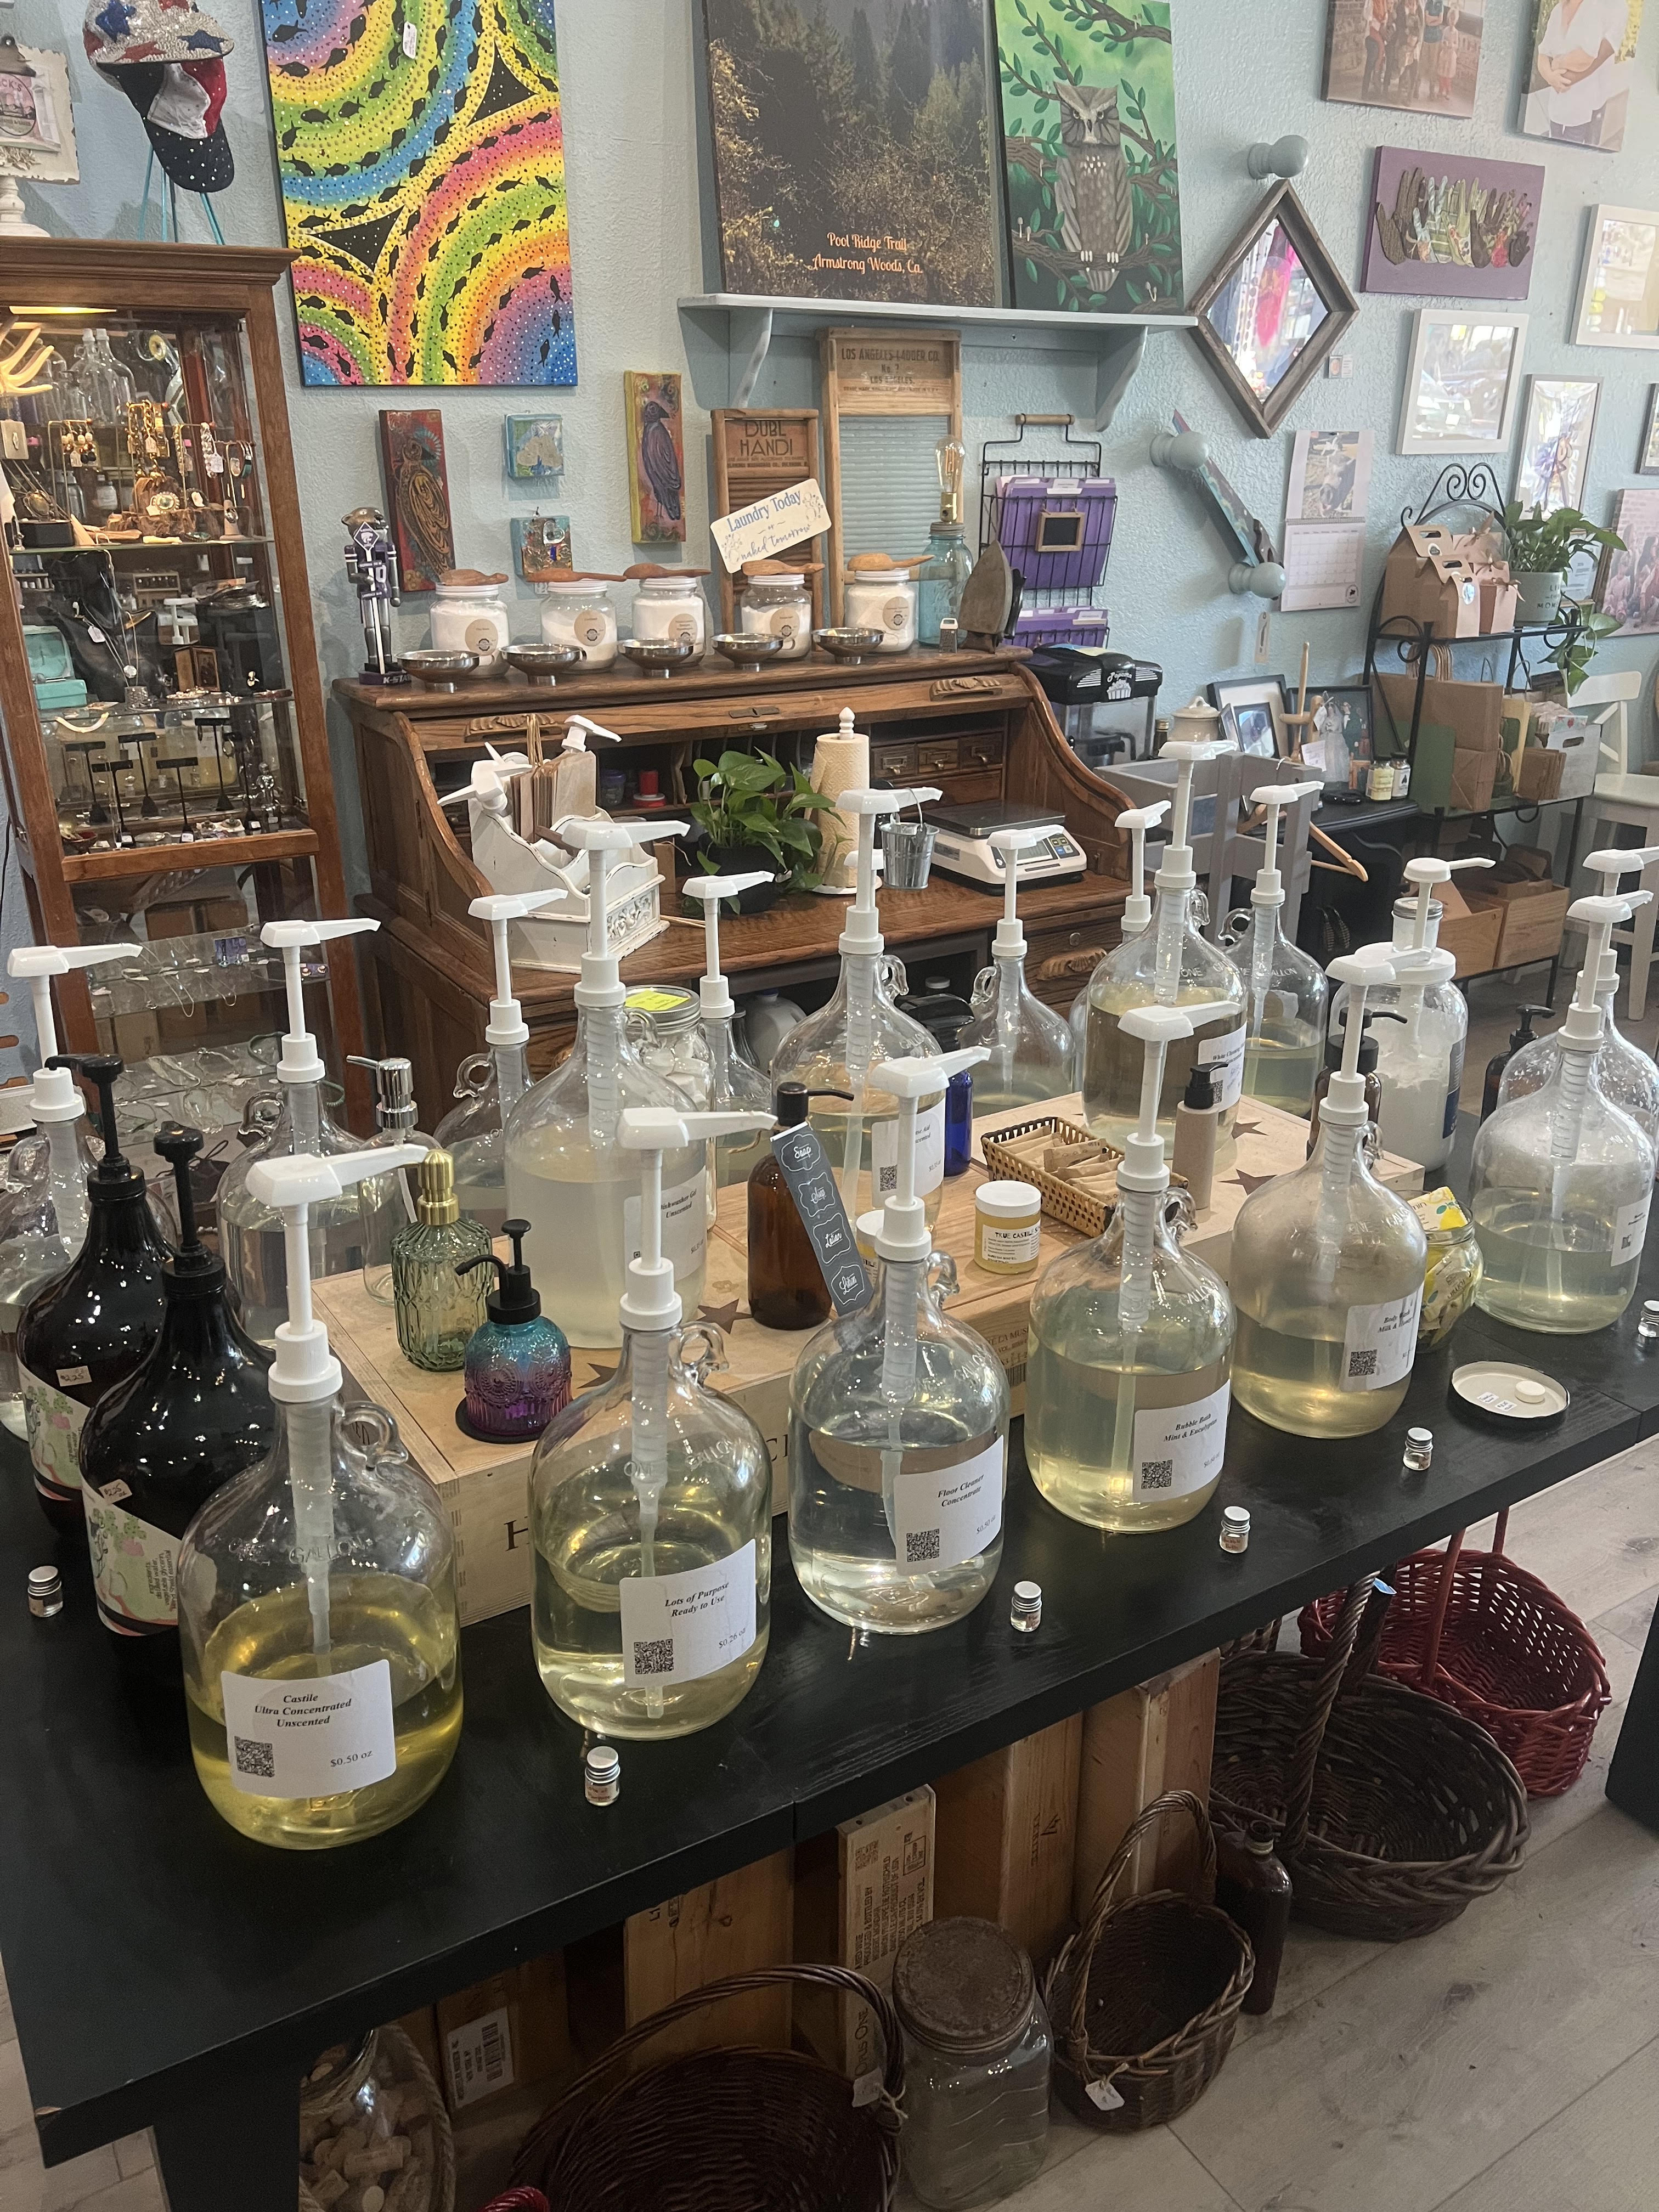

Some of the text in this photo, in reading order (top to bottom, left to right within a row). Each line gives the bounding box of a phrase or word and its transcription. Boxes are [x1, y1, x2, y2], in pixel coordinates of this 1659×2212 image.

[827, 232, 907, 253] Pool Ridge Trail
[812, 253, 923, 274] Armstrong Woods, Ca.
[842, 348, 939, 361] LOS ANGELES LADDER CO.
[746, 420, 786, 437] DUBL
[740, 439, 792, 456] HANDI
[727, 490, 801, 532] Laundry Today
[741, 523, 811, 560] naked tomorrow
[1272, 967, 1297, 977] ALLON
[794, 1144, 812, 1159] Soap
[665, 1201, 692, 1218] Unscented
[825, 1231, 843, 1248] Lotion
[1013, 1230, 1034, 1239] CASTILE
[1384, 1315, 1397, 1324] Body
[1176, 1420, 1198, 1431] Bubble
[938, 1474, 984, 1498] Floor Cleaner
[941, 1486, 981, 1507] Concentrate
[686, 1593, 697, 1602] of
[697, 1582, 729, 1599] Purpose
[672, 1605, 698, 1617] Ready
[711, 1595, 725, 1605] Use
[283, 1694, 318, 1703] Castile
[255, 1699, 352, 1716] Ultra Concentrated
[276, 1716, 330, 1728] Unscented
[330, 1754, 358, 1767] $0.50
